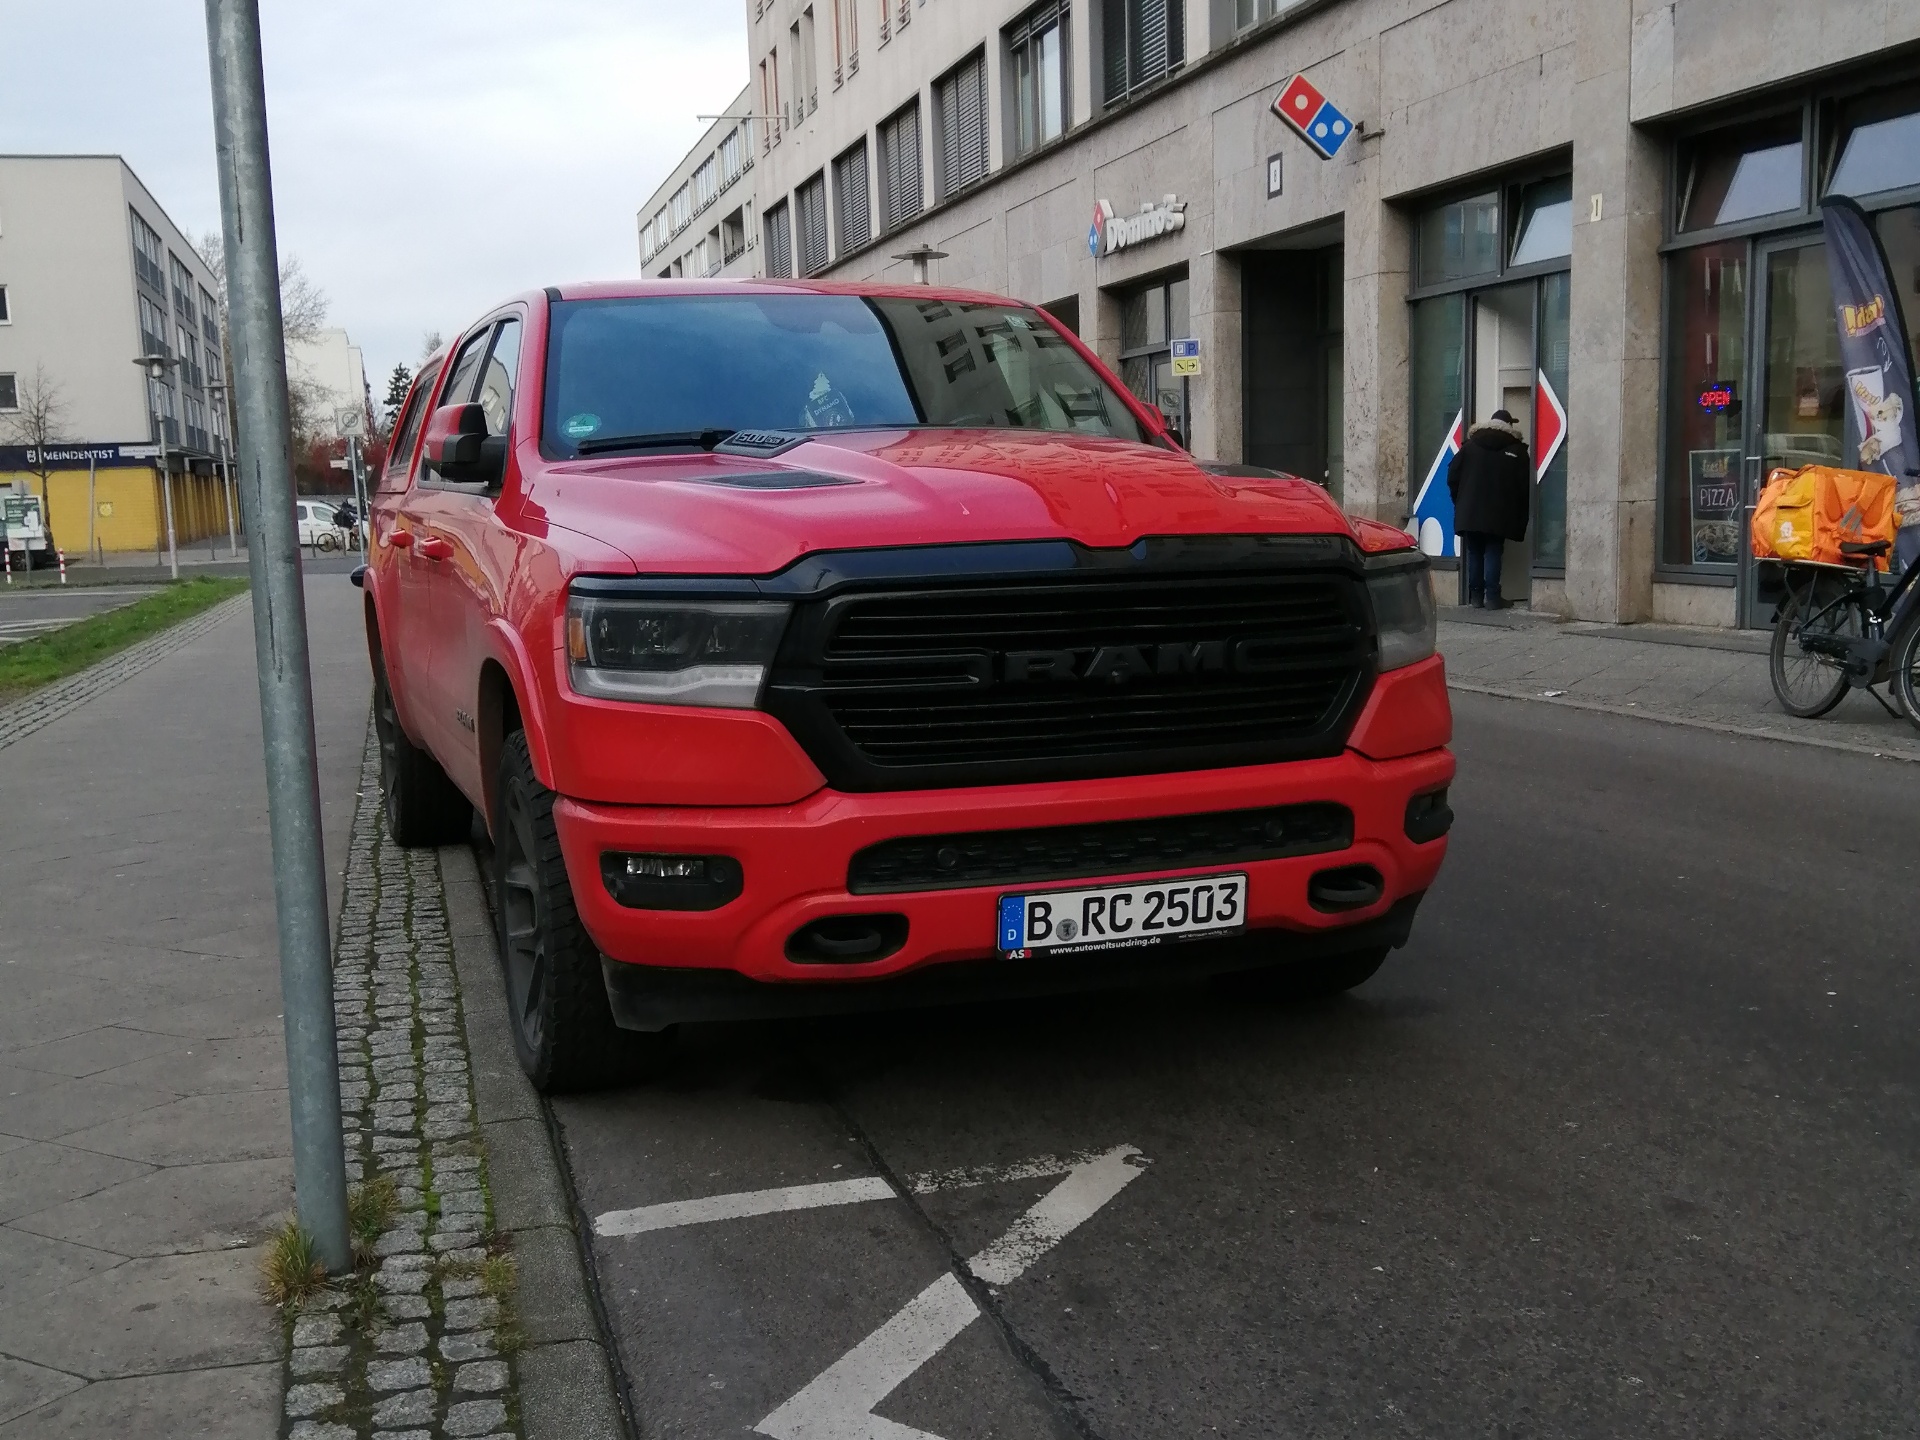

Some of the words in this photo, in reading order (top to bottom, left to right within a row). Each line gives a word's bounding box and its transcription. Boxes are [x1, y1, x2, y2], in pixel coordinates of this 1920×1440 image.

[1106, 196, 1181, 251] Domino's
[814, 398, 840, 416] DYNAMO
[1702, 391, 1730, 406] OPEN
[735, 432, 767, 443] 1500
[43, 449, 114, 461] MEINDENTIST
[1700, 487, 1735, 507] PIZZA
[1004, 641, 1226, 682] RAM
[1027, 901, 1052, 941] B
[1082, 893, 1133, 937] RC
[1142, 882, 1239, 931] 2503
[1008, 929, 1017, 941] D
[1050, 936, 1161, 955] www.autoweltsuedring.de
